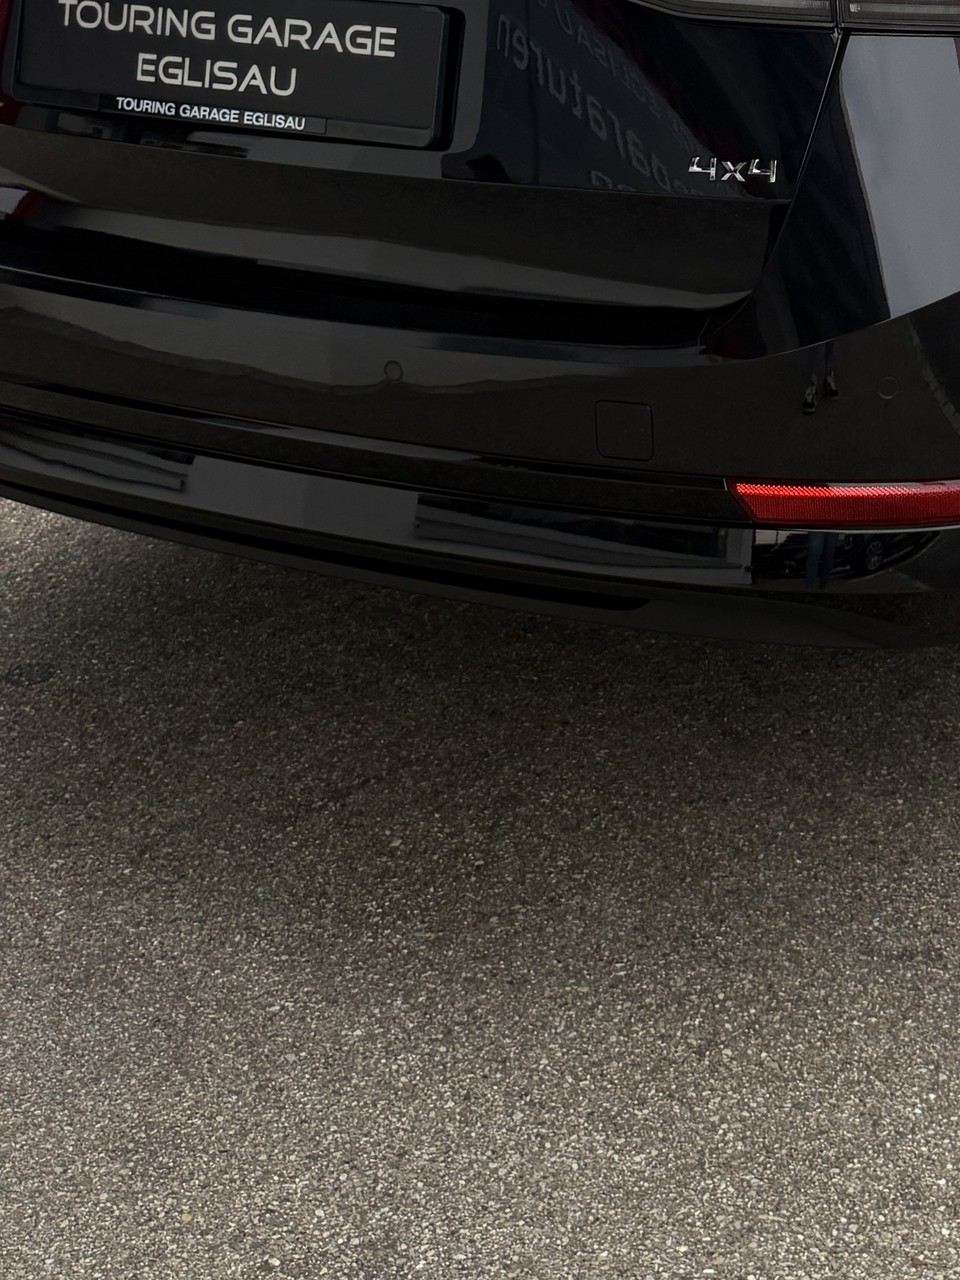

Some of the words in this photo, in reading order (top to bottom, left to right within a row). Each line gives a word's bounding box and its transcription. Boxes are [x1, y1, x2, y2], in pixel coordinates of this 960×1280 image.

[227, 14, 398, 58] GARAGE
[136, 52, 297, 97] EGLISAU
[116, 96, 176, 116] TOURING
[179, 105, 239, 124] GARAGE
[243, 112, 305, 131] EGLISAU
